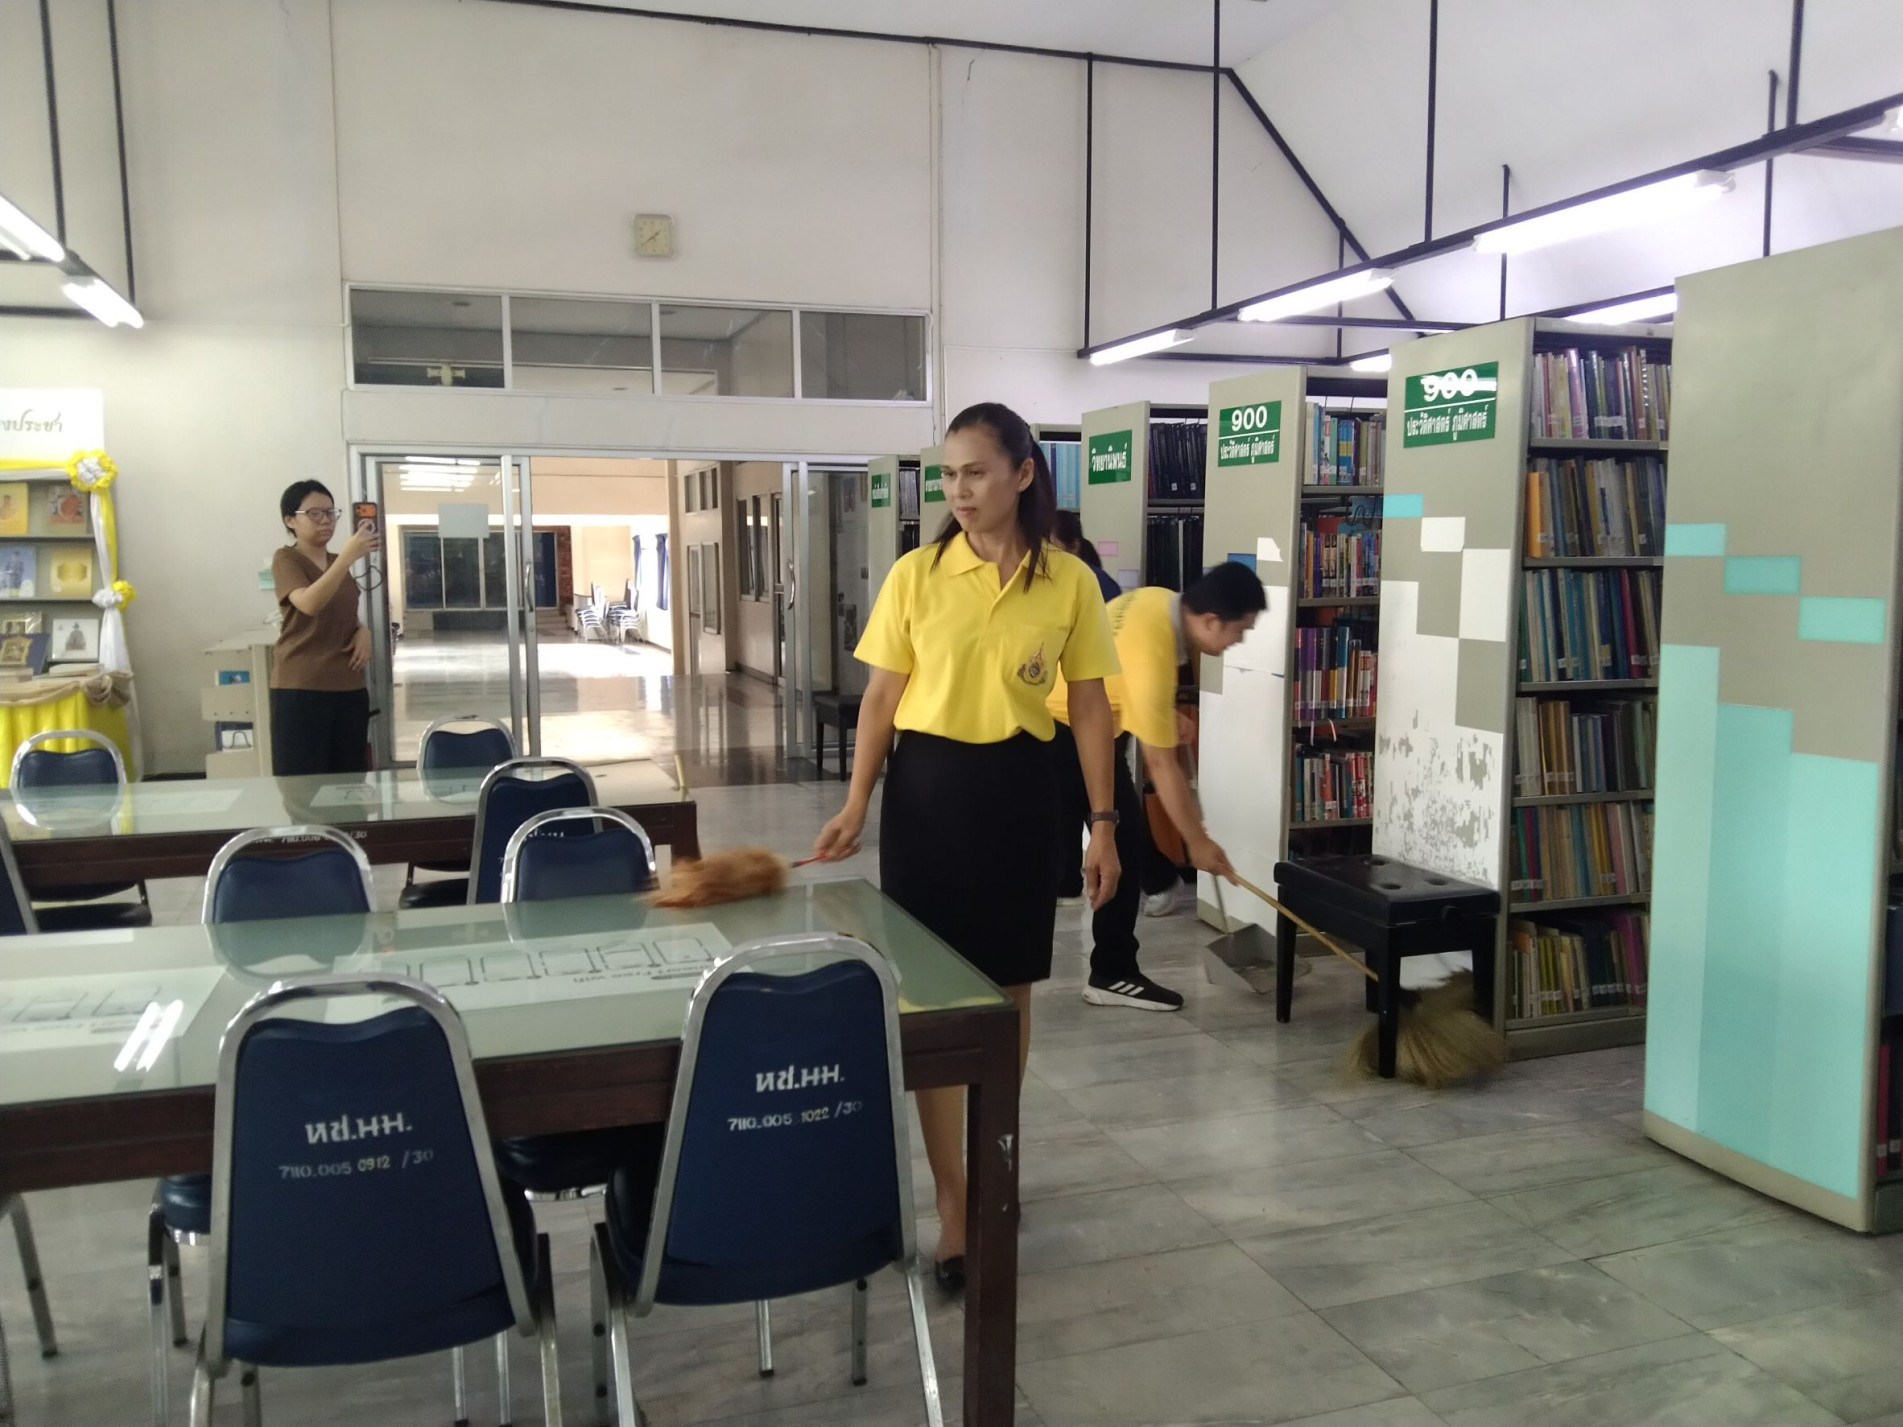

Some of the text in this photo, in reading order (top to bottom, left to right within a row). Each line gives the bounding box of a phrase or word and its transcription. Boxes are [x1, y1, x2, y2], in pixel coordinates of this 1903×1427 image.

[1231, 405, 1268, 432] 900
[1091, 442, 1128, 472] วิทยานิพนธ์
